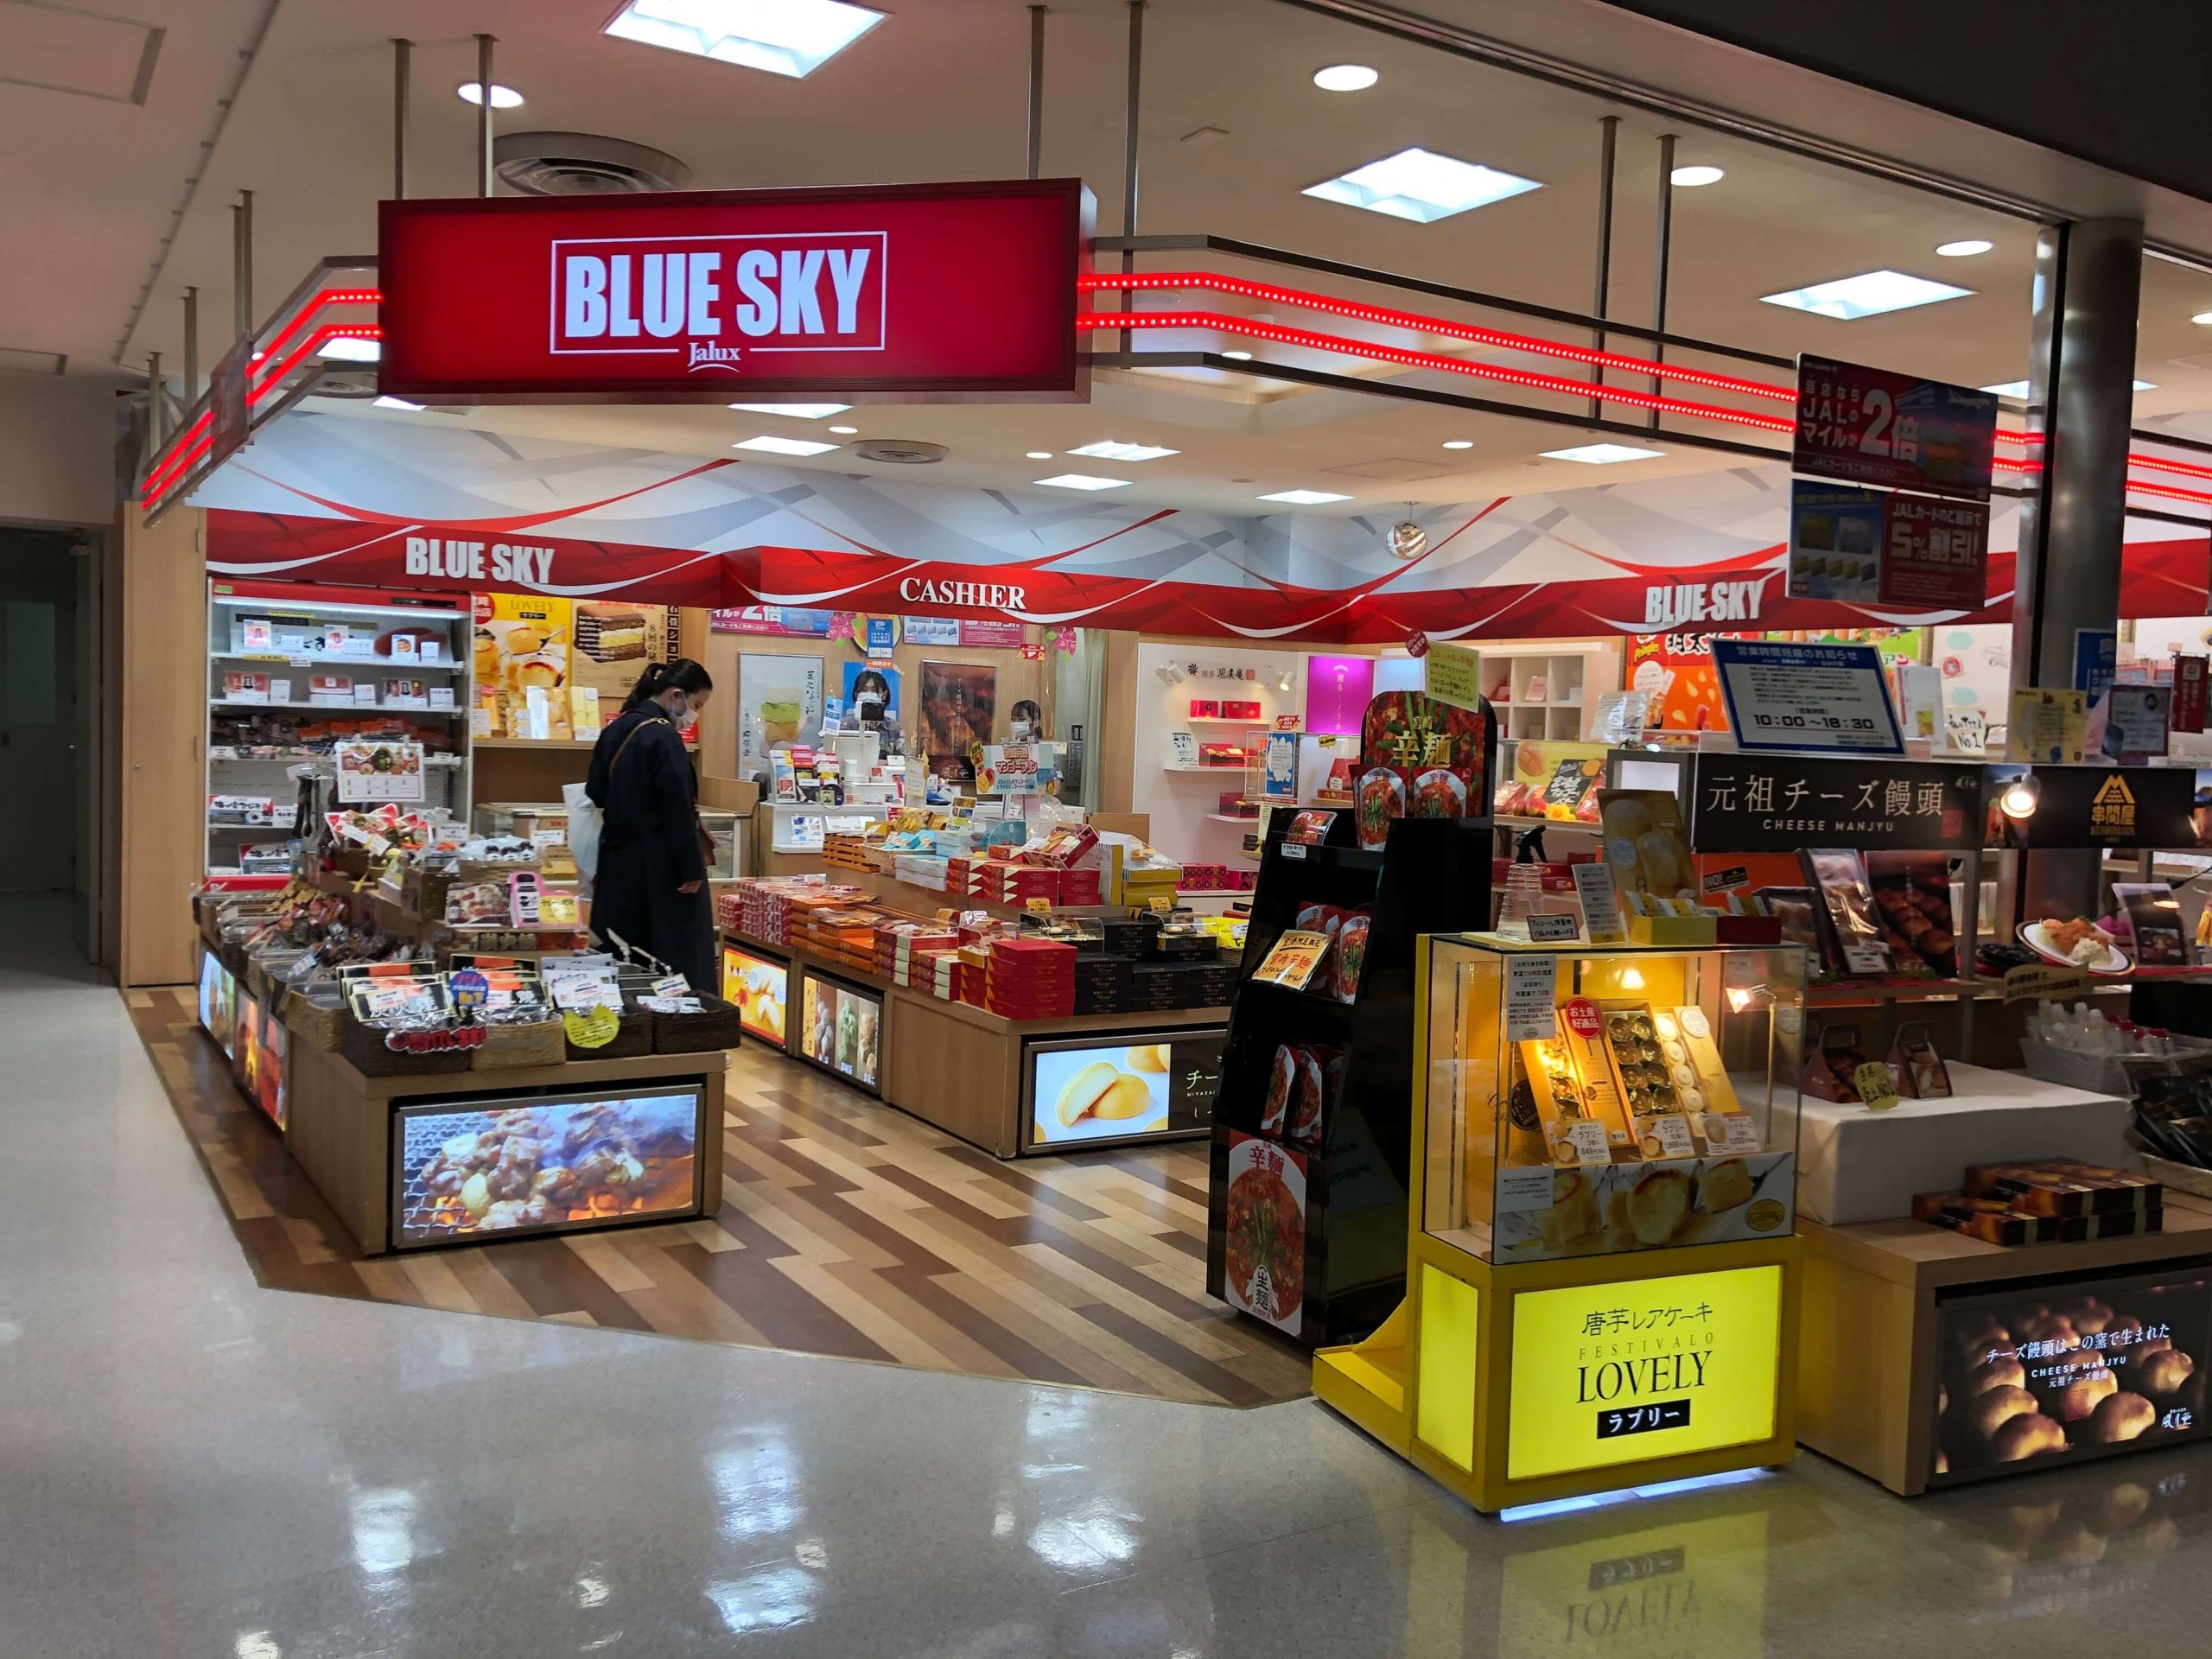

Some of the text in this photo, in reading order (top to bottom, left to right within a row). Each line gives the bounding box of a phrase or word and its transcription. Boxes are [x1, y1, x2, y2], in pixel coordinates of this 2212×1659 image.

[564, 249, 870, 339] BLUE SKY
[688, 342, 741, 365] Jalux
[1859, 388, 1920, 463] 2倍
[405, 537, 555, 584] BLUE SKY
[510, 599, 556, 613] LOVELY
[899, 577, 1027, 610] CASHIER
[1645, 580, 1766, 625] BLUE SKY
[1706, 774, 1944, 817] 元祖チーズ饅頭
[1763, 819, 1895, 832] CHEESE MANJYU
[1569, 1007, 1597, 1018] お土産
[1580, 1301, 1714, 1337] 唐芋レアケーキ
[1986, 1322, 2171, 1364] チーズ饅頭はこの窯で生まれた
[1576, 1350, 1714, 1404] LOVELY
[2031, 1355, 2127, 1378] CHEESE MANJYU
[1608, 1408, 1681, 1433] ラブリー
